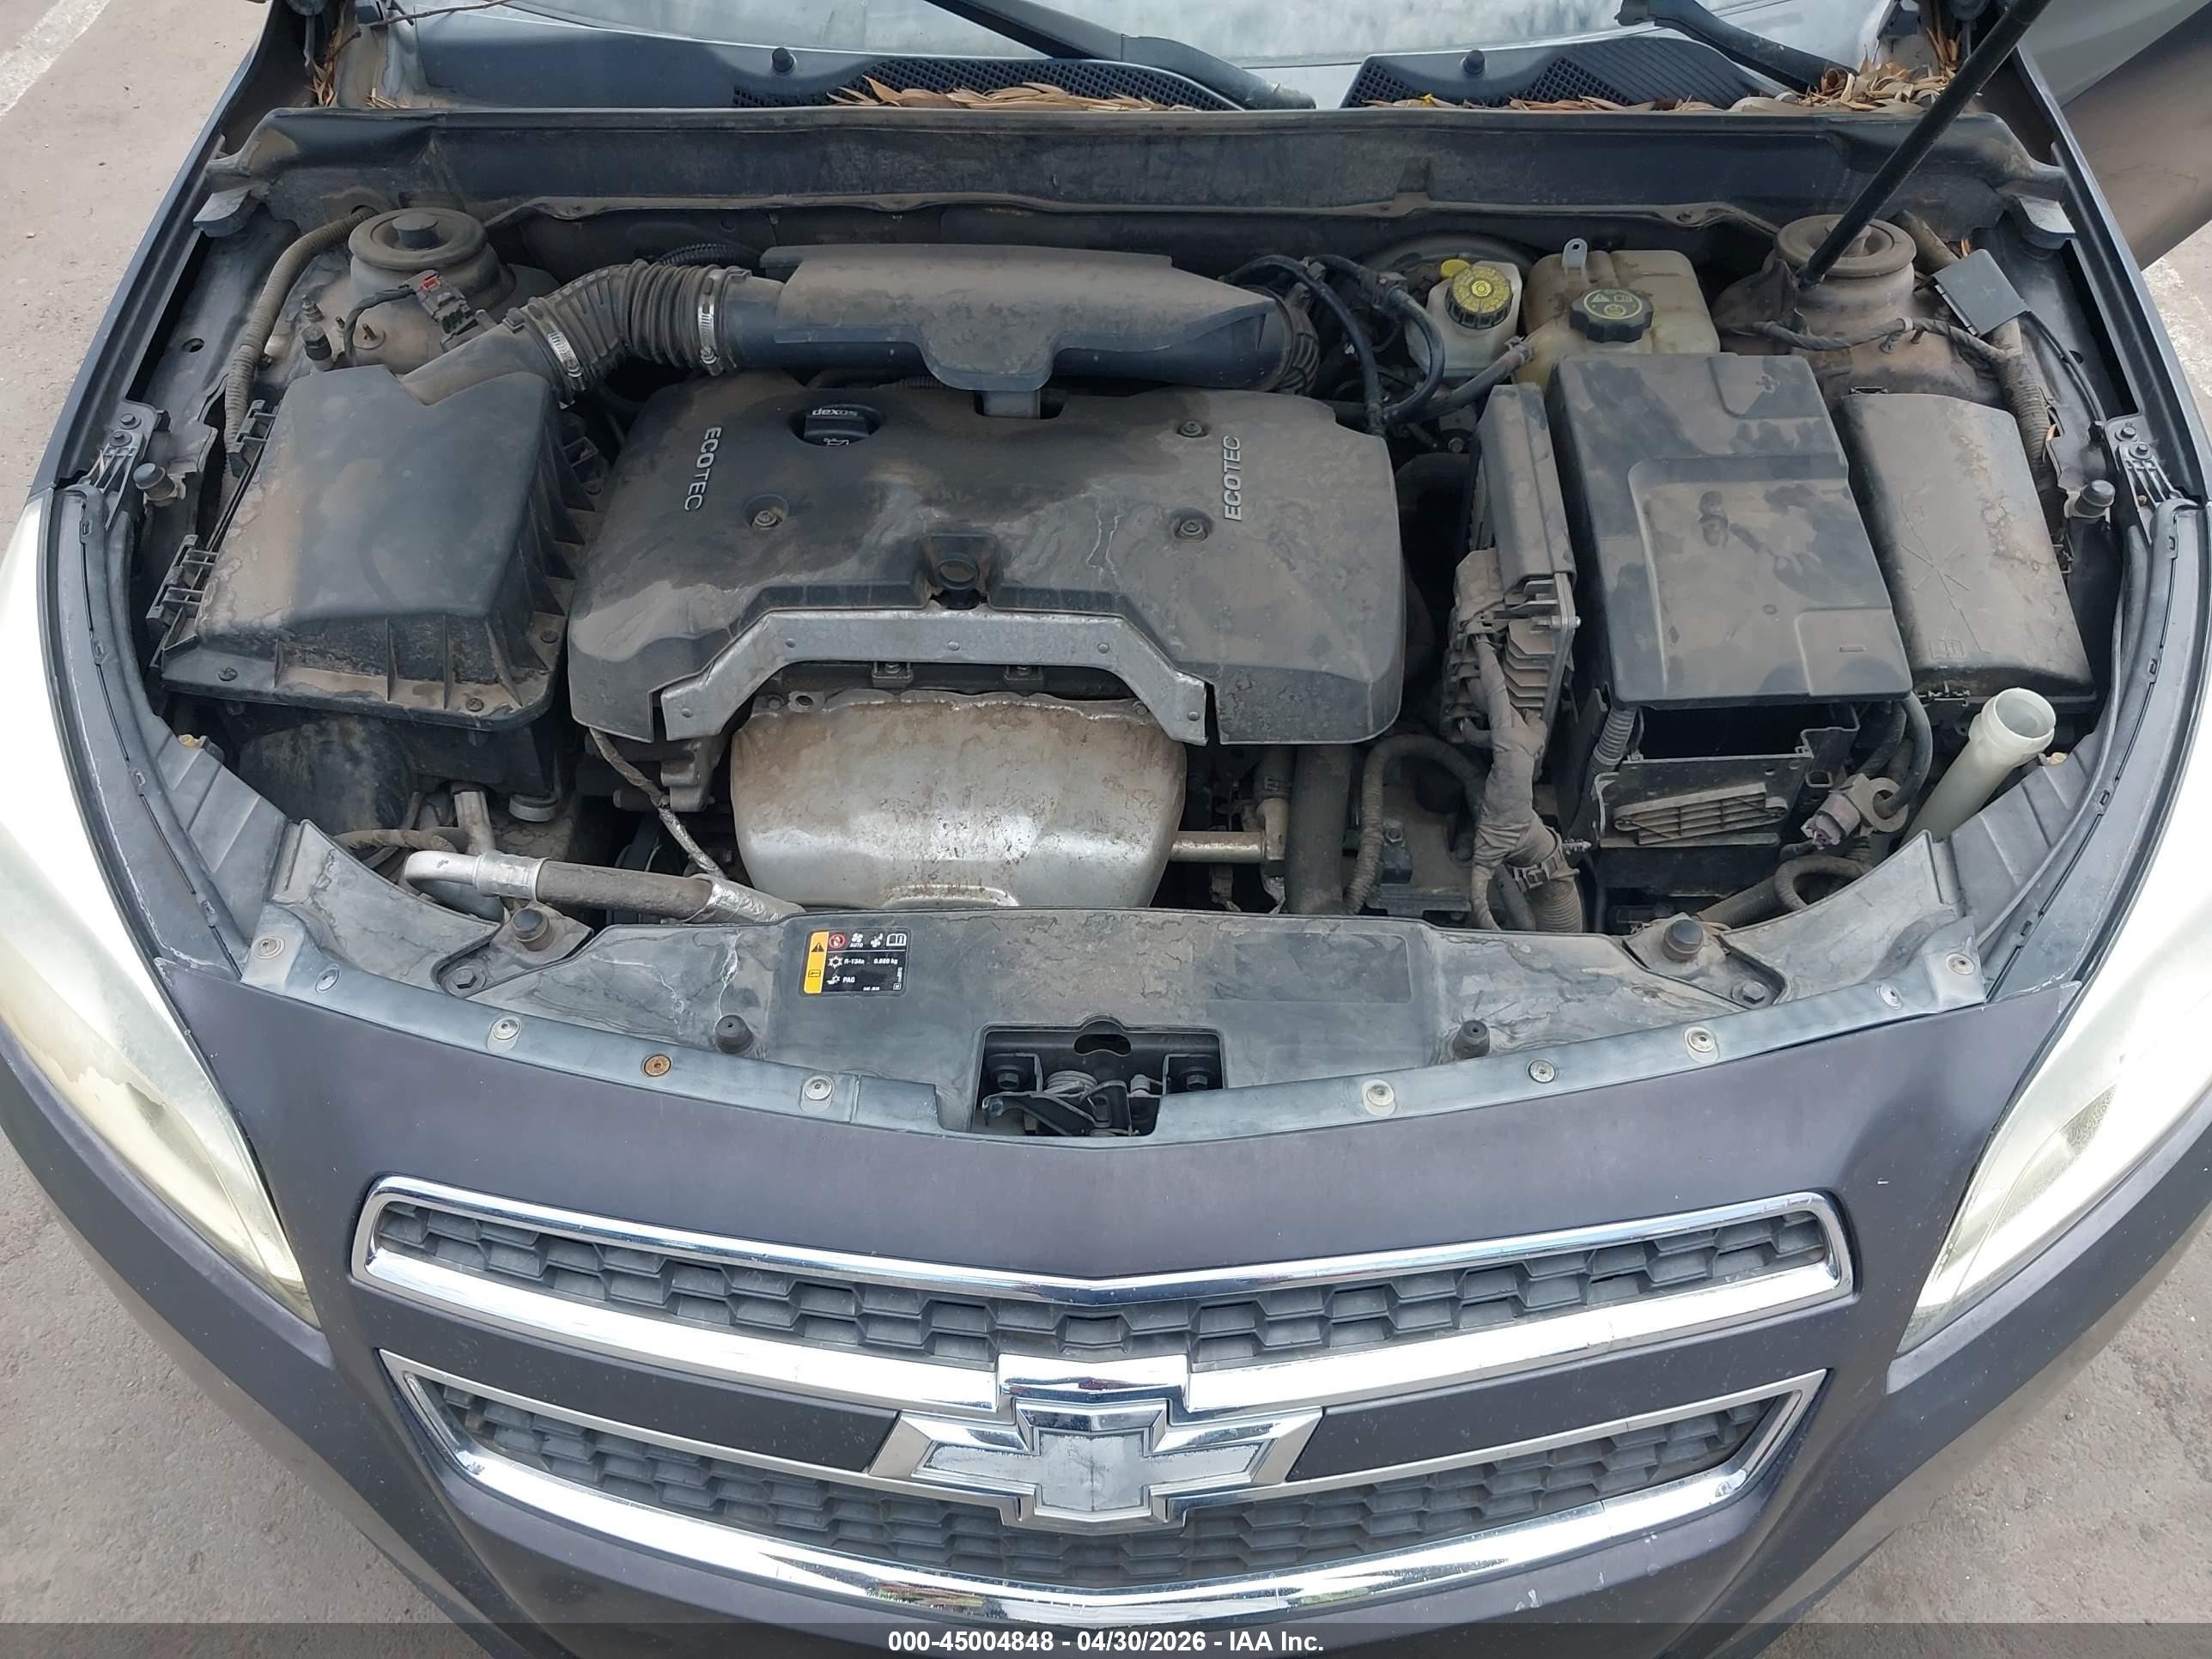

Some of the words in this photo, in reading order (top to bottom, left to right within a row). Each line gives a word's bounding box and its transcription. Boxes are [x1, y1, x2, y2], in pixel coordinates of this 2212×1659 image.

[811, 408, 858, 416] dexos
[684, 427, 721, 511] ECOTEC
[1223, 435, 1242, 520] ECOTEC
